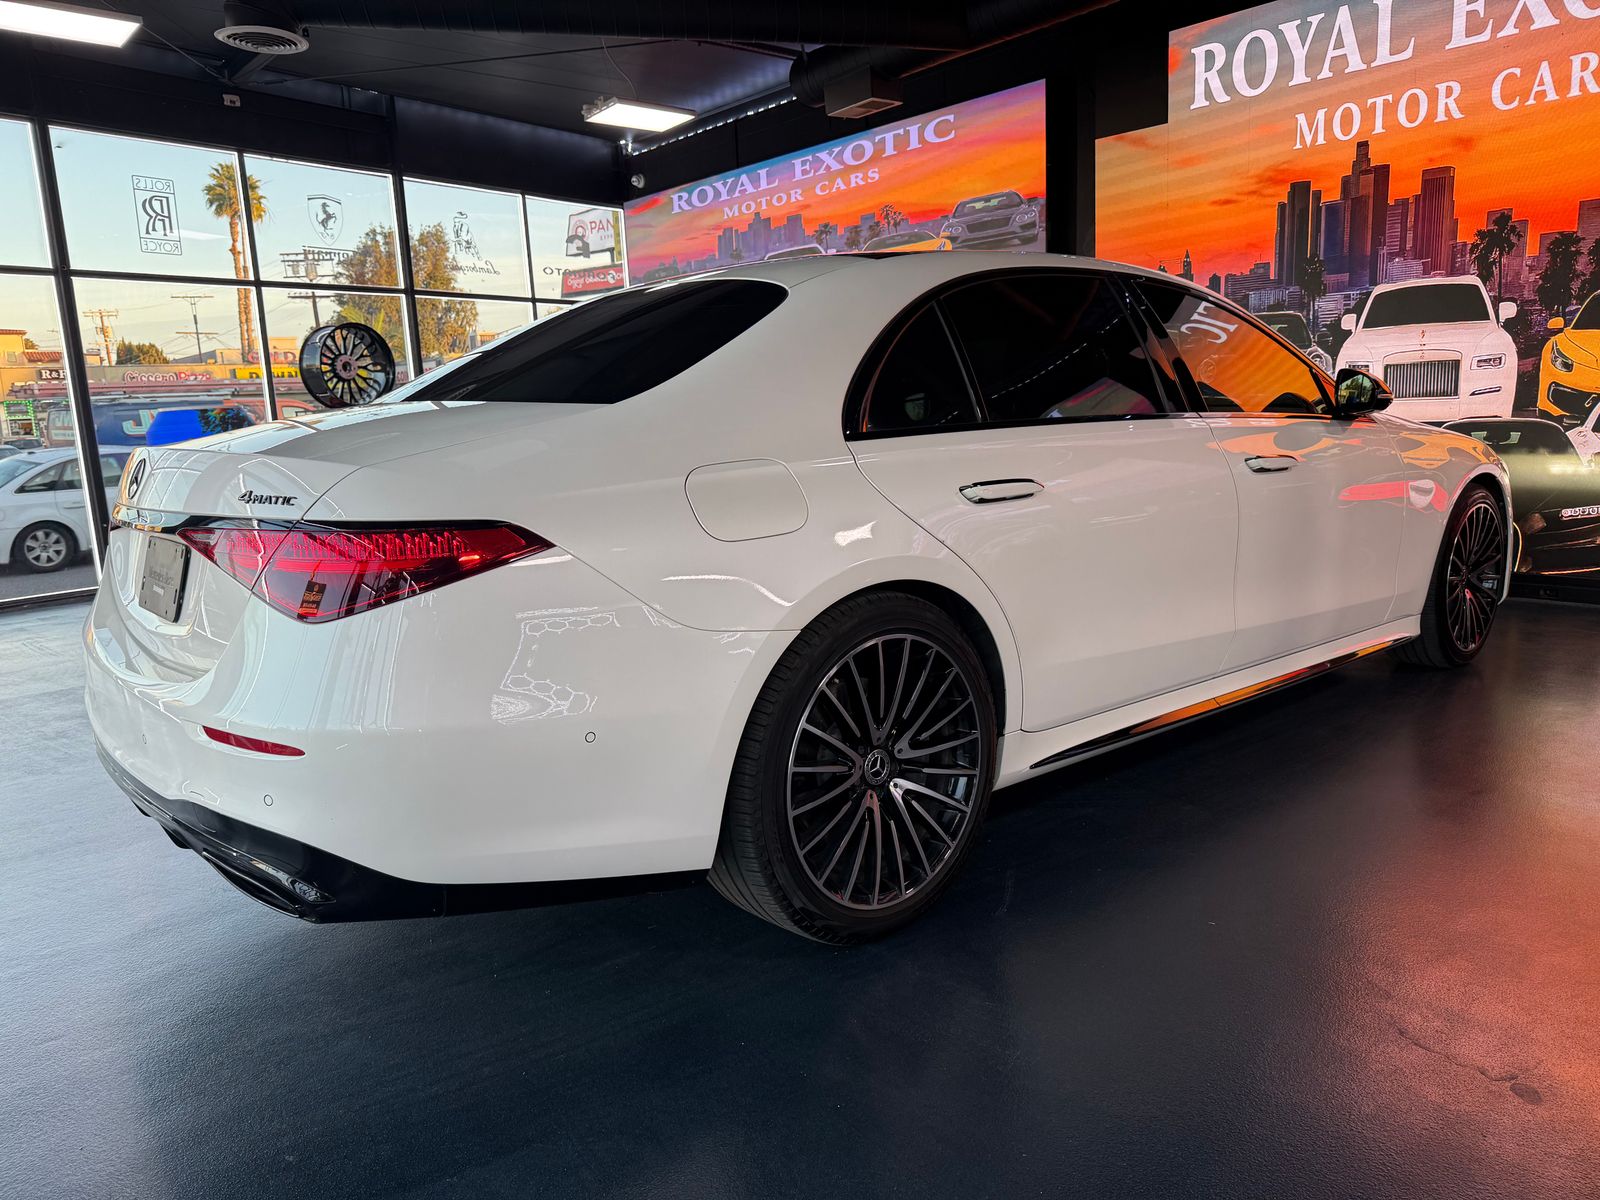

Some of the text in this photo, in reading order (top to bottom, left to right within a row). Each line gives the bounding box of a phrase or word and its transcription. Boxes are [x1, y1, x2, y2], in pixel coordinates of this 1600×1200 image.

[1190, 0, 1415, 110] ROYAL
[1293, 81, 1465, 149] MOTOR
[670, 114, 956, 214] ROYAL EXOTIC
[723, 168, 880, 219] MOTOR CARS
[238, 490, 298, 506] 4MATIC
